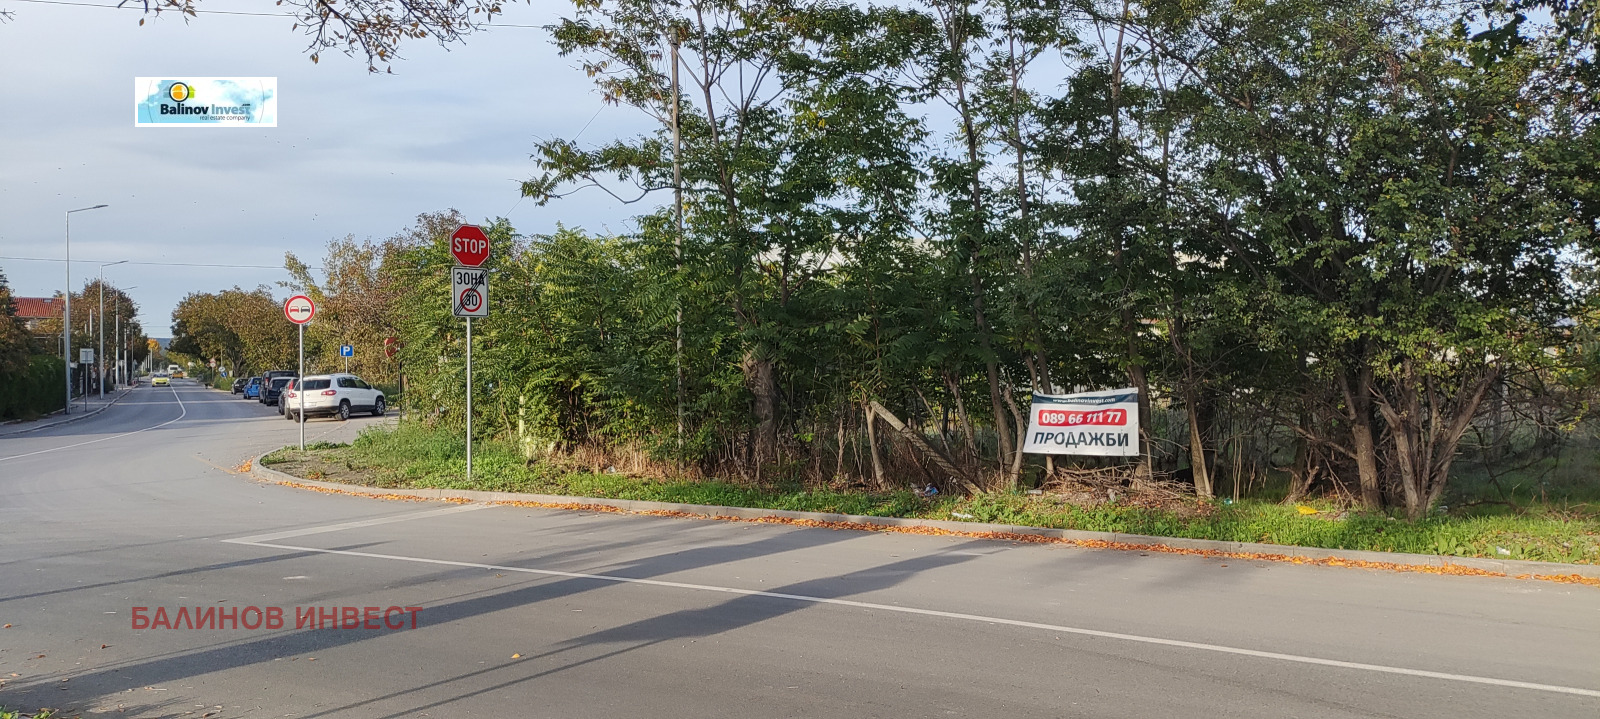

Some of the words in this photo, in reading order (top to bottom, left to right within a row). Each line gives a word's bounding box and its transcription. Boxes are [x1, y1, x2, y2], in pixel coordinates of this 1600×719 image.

[454, 237, 487, 255] STOP
[456, 271, 485, 286] ЗОНА
[464, 294, 478, 306] 30
[343, 346, 351, 356] P
[1042, 412, 1065, 424] 089
[1068, 413, 1083, 424] 66
[1086, 412, 1103, 423] 111
[1106, 411, 1121, 423] 77
[1033, 431, 1129, 448] ПРОДАЖБИ
